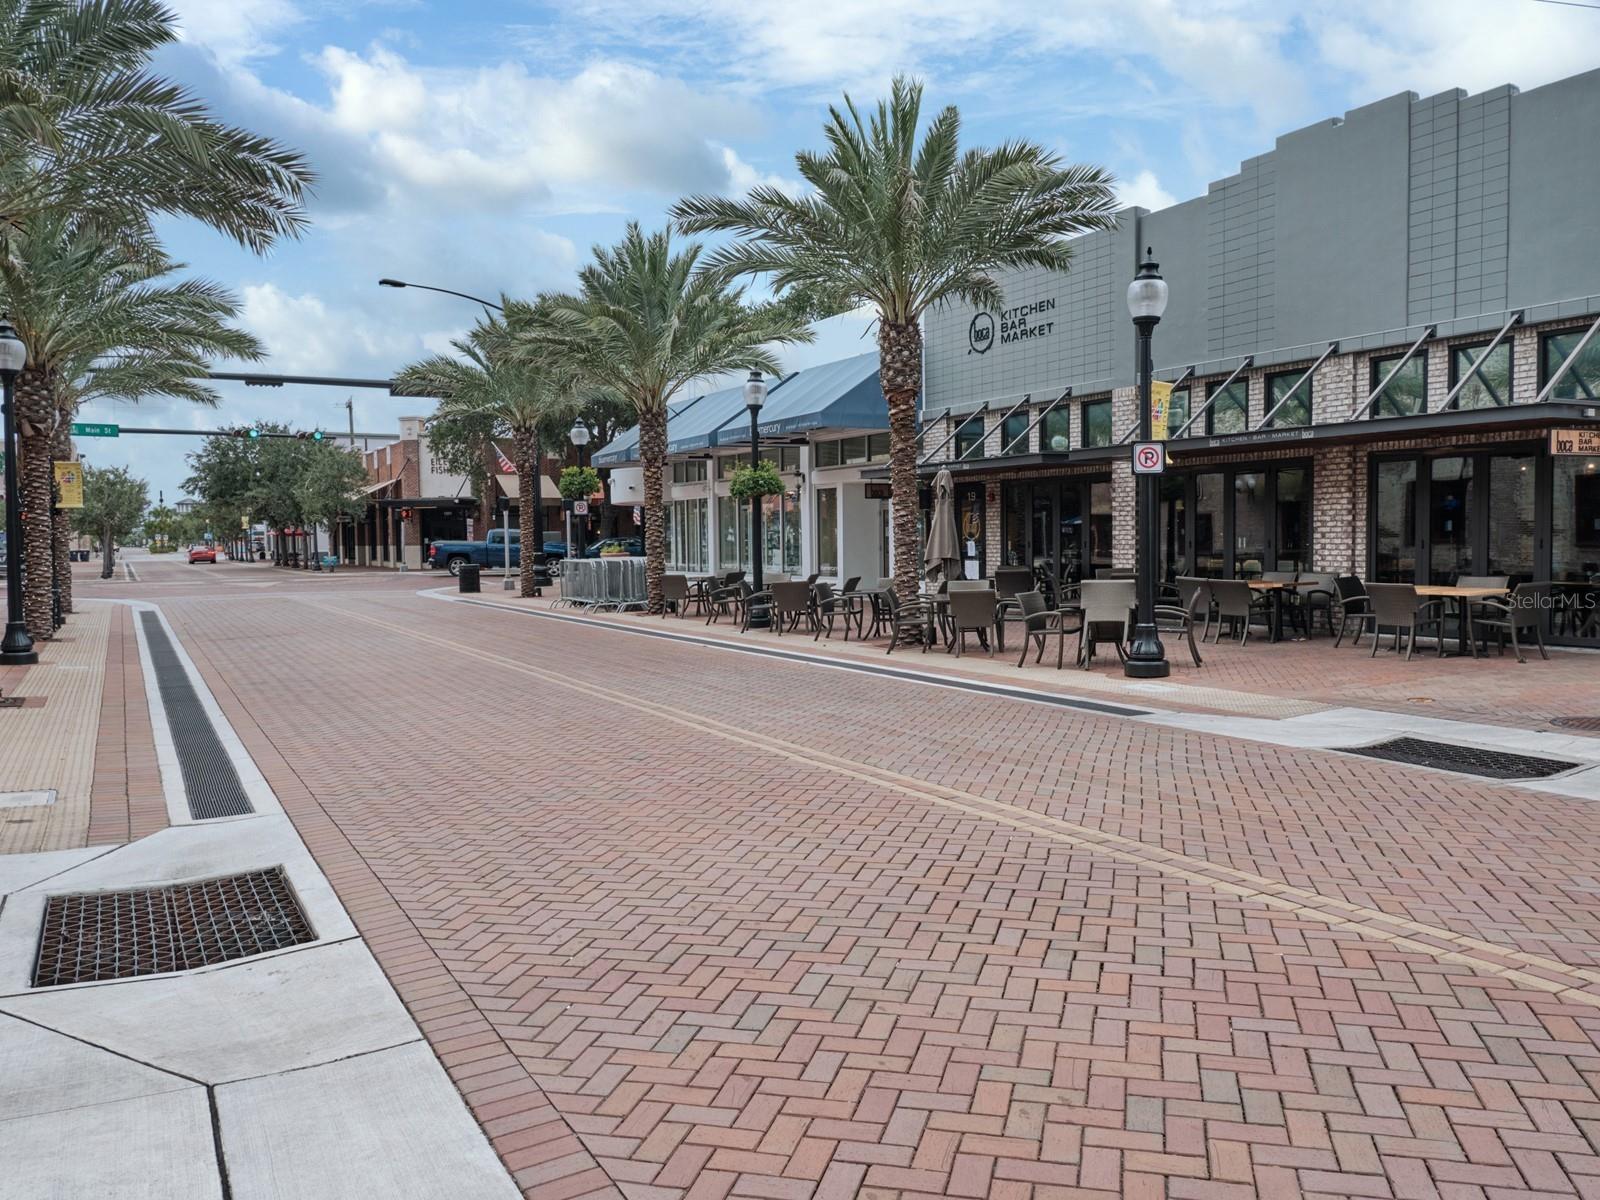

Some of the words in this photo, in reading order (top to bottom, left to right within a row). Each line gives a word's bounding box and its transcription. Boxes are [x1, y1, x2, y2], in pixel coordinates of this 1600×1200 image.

[1000, 298, 1056, 322] KITCHEN
[1000, 317, 1027, 333] BAR
[1000, 322, 1055, 345] MARKET
[85, 426, 100, 434] Main
[1271, 430, 1299, 438] MARKET
[1578, 431, 1600, 439] KITCHE
[1556, 431, 1574, 452] boca
[967, 491, 976, 502] 19
